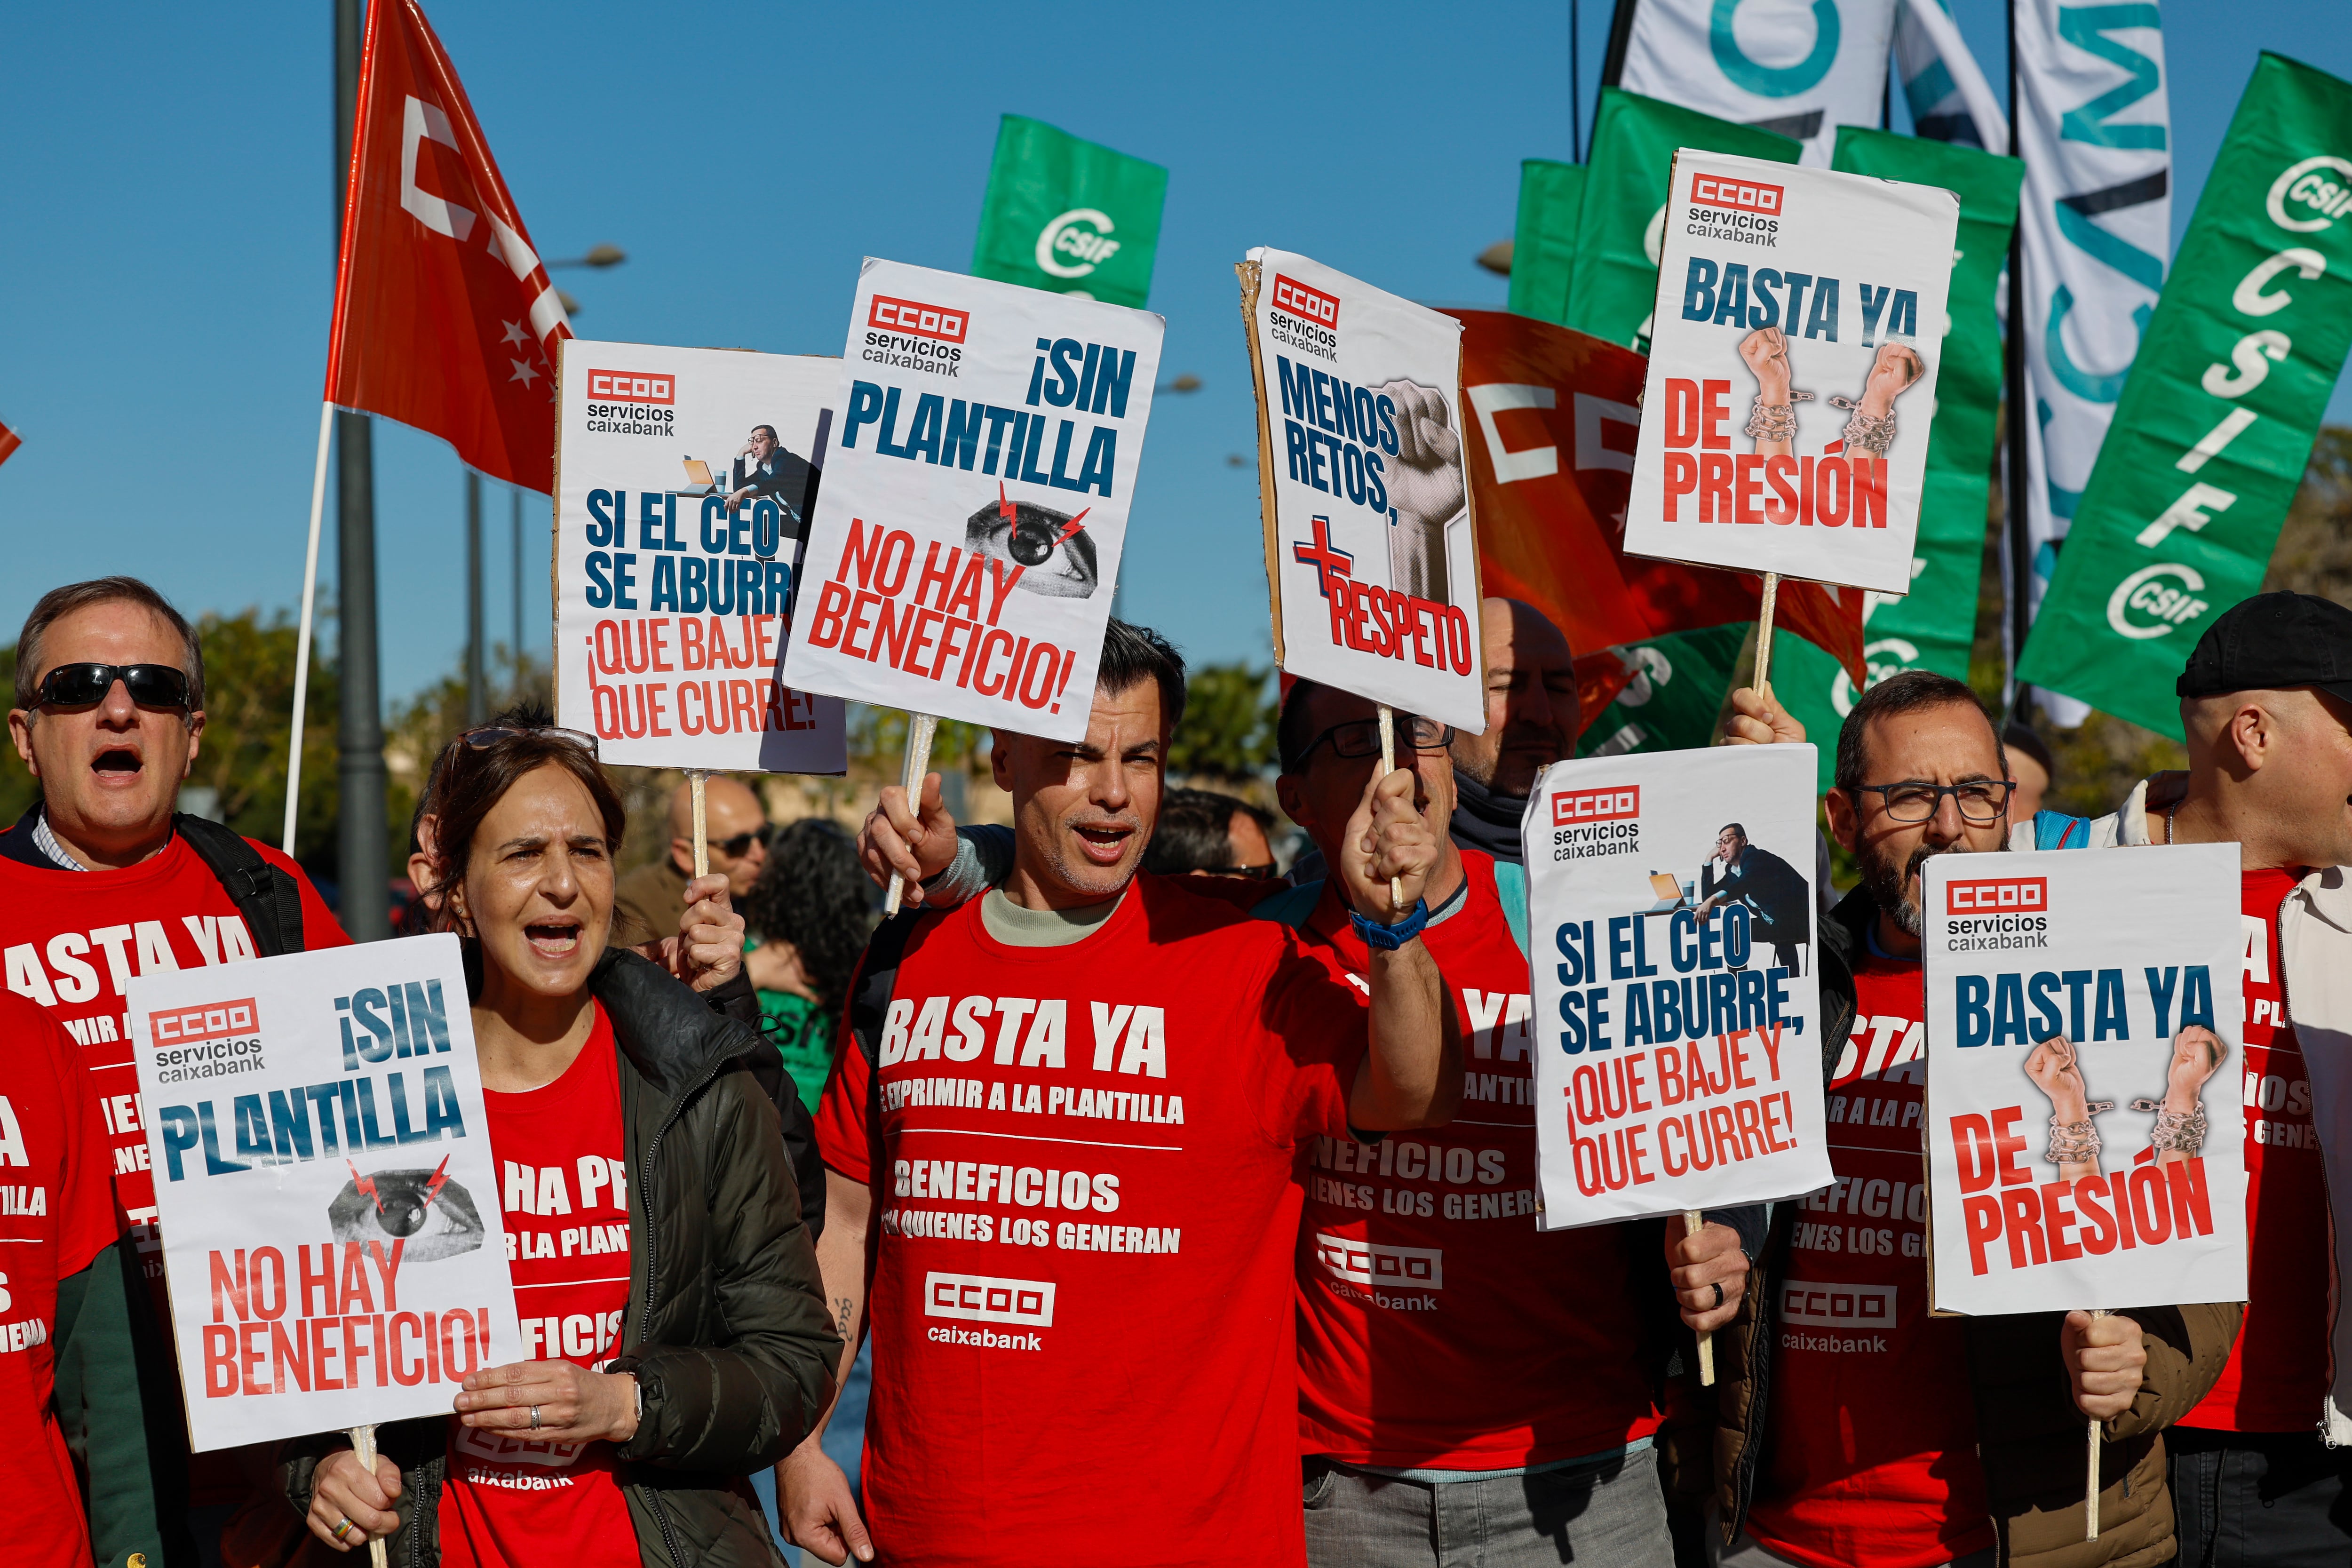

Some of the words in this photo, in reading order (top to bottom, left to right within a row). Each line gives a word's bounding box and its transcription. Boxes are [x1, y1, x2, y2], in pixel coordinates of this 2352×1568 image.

[1695, 179, 1778, 210] CCOO
[1686, 222, 1778, 248] caixabank
[1688, 207, 1779, 233] servicios
[874, 302, 964, 338] CCOO
[1276, 281, 1336, 323] CCOO
[1681, 256, 1840, 343] BASTA
[1859, 283, 1918, 352] YA
[864, 332, 962, 362] servicios
[1269, 311, 1336, 349] servicios
[1271, 327, 1338, 364] caixabank
[862, 347, 959, 377] caixabank
[1025, 337, 1137, 419] ¡SIN
[591, 375, 670, 399] CCOO
[1276, 354, 1400, 457] MENOS
[2136, 247, 2327, 549] CSIF
[587, 404, 675, 422] servicios
[587, 420, 674, 437] caixabank
[1664, 378, 1731, 451] DE
[841, 380, 1117, 498] PLANTILLA
[1284, 418, 1399, 526] RETOS,
[1663, 438, 1889, 529] PRESIÓN
[586, 488, 626, 549] SI
[640, 492, 687, 552] EL
[700, 495, 780, 558] CEO
[585, 551, 637, 610] SE
[650, 556, 793, 618] ABURR
[836, 517, 915, 598] NO
[915, 540, 1027, 628] HAY
[807, 580, 1076, 714] BENEFICIO!
[1327, 574, 1472, 677] RESPETO
[585, 618, 675, 690] ¡QUE
[678, 614, 779, 672] BAJE
[592, 682, 671, 741] QUE
[1555, 790, 1635, 820] CCOO
[1553, 822, 1639, 844] servicios
[1553, 840, 1640, 862] caixabank
[1951, 882, 2042, 910] CCOO
[1555, 919, 1595, 987] SI
[1609, 913, 1658, 981] EL
[1669, 903, 1752, 974] CEO
[1947, 913, 2048, 935] servicios
[1947, 931, 2049, 952] caixabank
[4, 920, 181, 1007] ASTA
[156, 1009, 254, 1042] CCOO
[333, 978, 451, 1072] ¡SIN
[1559, 987, 1612, 1055] SE
[1624, 966, 1805, 1049] ABURRE,
[1955, 969, 2130, 1049] BASTA
[2144, 964, 2216, 1039] YA
[156, 1038, 262, 1067] servicios
[879, 995, 1067, 1068] BASTA
[1090, 1000, 1168, 1079] YA
[1832, 1014, 1925, 1086] STA
[158, 1055, 266, 1084] caixabank
[1564, 1051, 1652, 1146] ¡QUE
[1655, 1028, 1756, 1106] BAJE
[1763, 1021, 1784, 1083] Y
[159, 1065, 467, 1182] PLANTILLA
[988, 1082, 1011, 1111] A
[1012, 1084, 1043, 1115] LA
[1048, 1086, 1185, 1125] PLANTILLA
[1848, 1097, 1866, 1124] A
[1869, 1098, 1899, 1127] LA
[1311, 1134, 1505, 1185] NEFICIOS
[1571, 1122, 1656, 1197] QUE
[1657, 1090, 1798, 1177] CURRE!
[1949, 1105, 2033, 1194] DE
[504, 1159, 572, 1216] HA
[894, 1160, 1120, 1213] BENEFICIOS
[1383, 1188, 1434, 1218] LOS
[1443, 1189, 1537, 1220] GENER
[900, 1209, 994, 1242] QUIENES
[1000, 1217, 1050, 1249] LOS
[1056, 1222, 1182, 1255] GENERAN
[1962, 1145, 2215, 1277] PRESIÓN
[521, 1231, 556, 1260] LA
[1323, 1243, 1432, 1281] CCOO
[1848, 1226, 1893, 1256] LOS
[209, 1246, 286, 1322] NO
[297, 1238, 405, 1317] HAY
[933, 1281, 1044, 1315] CCOO
[1784, 1289, 1886, 1318] CCOO
[202, 1307, 491, 1398] BENEFICIO!
[927, 1325, 1042, 1352] caixabank
[1782, 1332, 1887, 1353] caixabank
[464, 1465, 574, 1491] aixabank
